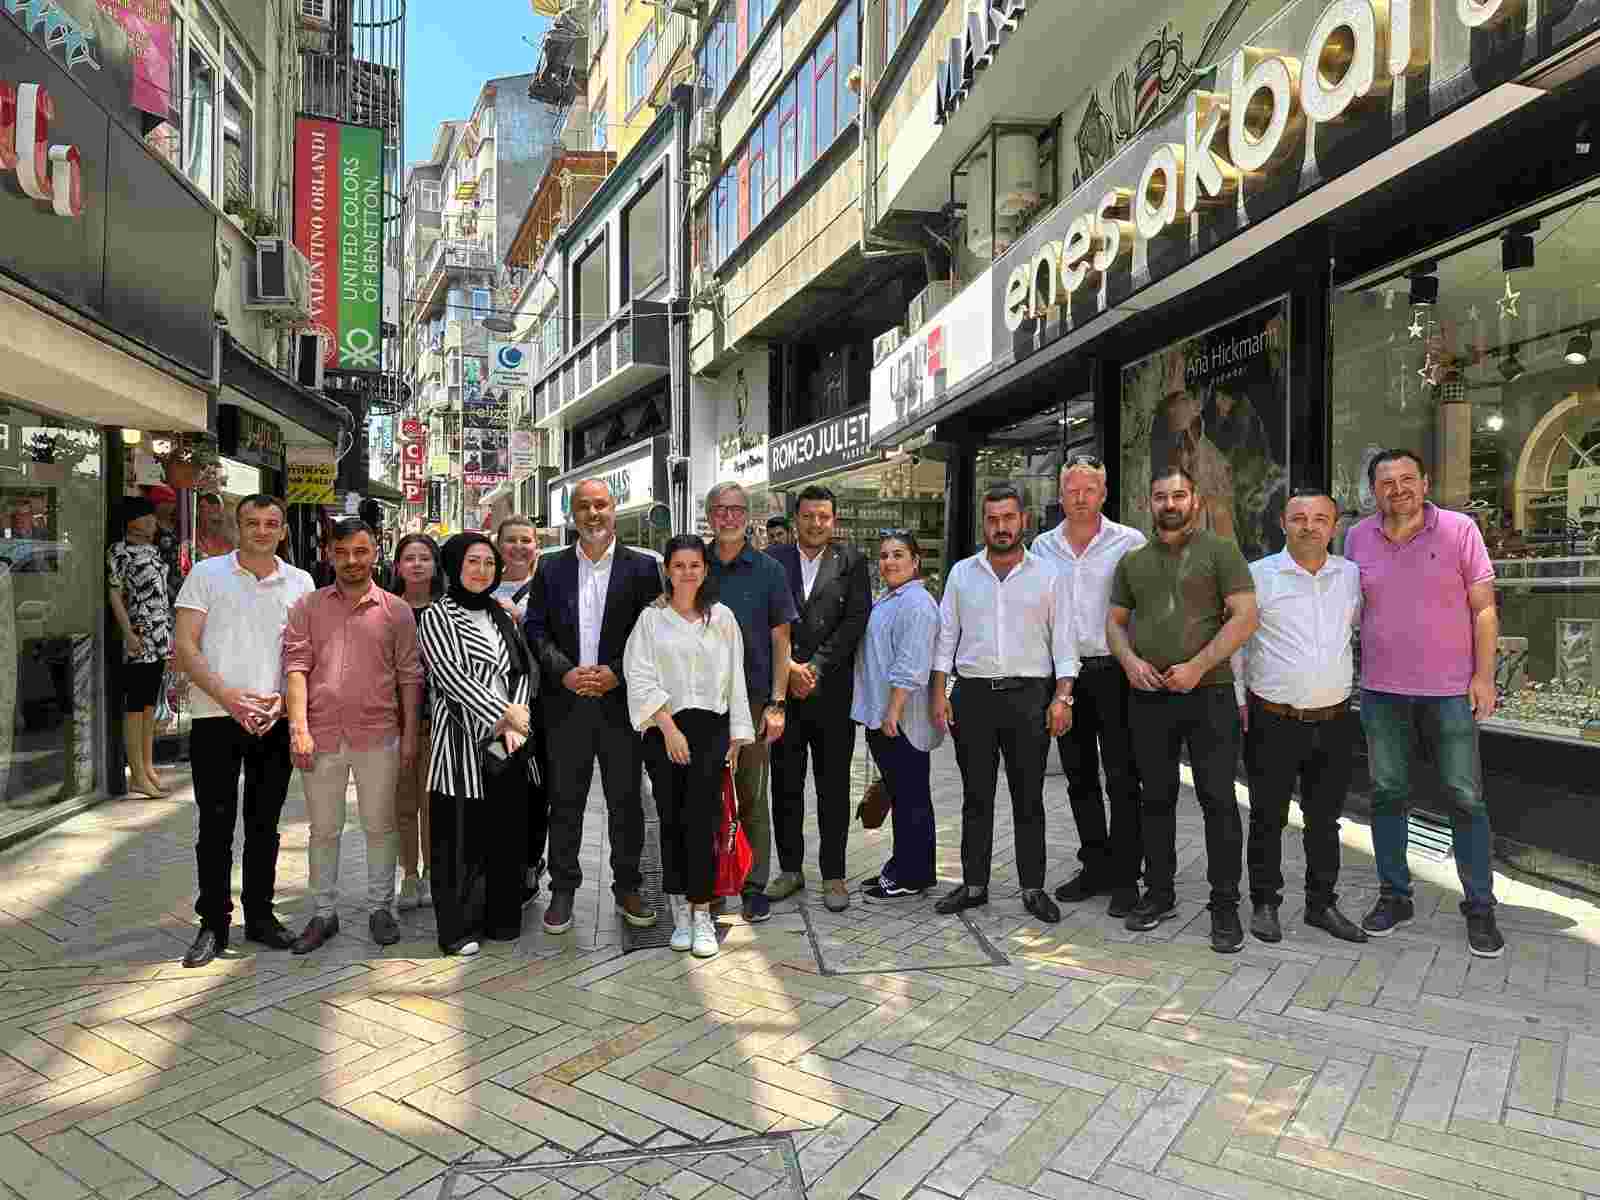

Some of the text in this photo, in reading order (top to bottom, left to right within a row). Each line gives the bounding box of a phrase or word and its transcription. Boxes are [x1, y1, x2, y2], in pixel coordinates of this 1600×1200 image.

[310, 129, 327, 317] VALENTINO ORLANDI
[343, 157, 360, 301] UNITED COLORS
[363, 276, 378, 302] OF
[1186, 355, 1209, 377] Ana
[1211, 327, 1281, 369] Hickmann
[772, 433, 815, 472] ROMEO
[816, 412, 869, 457] JULIET
[404, 443, 424, 500] CHP
